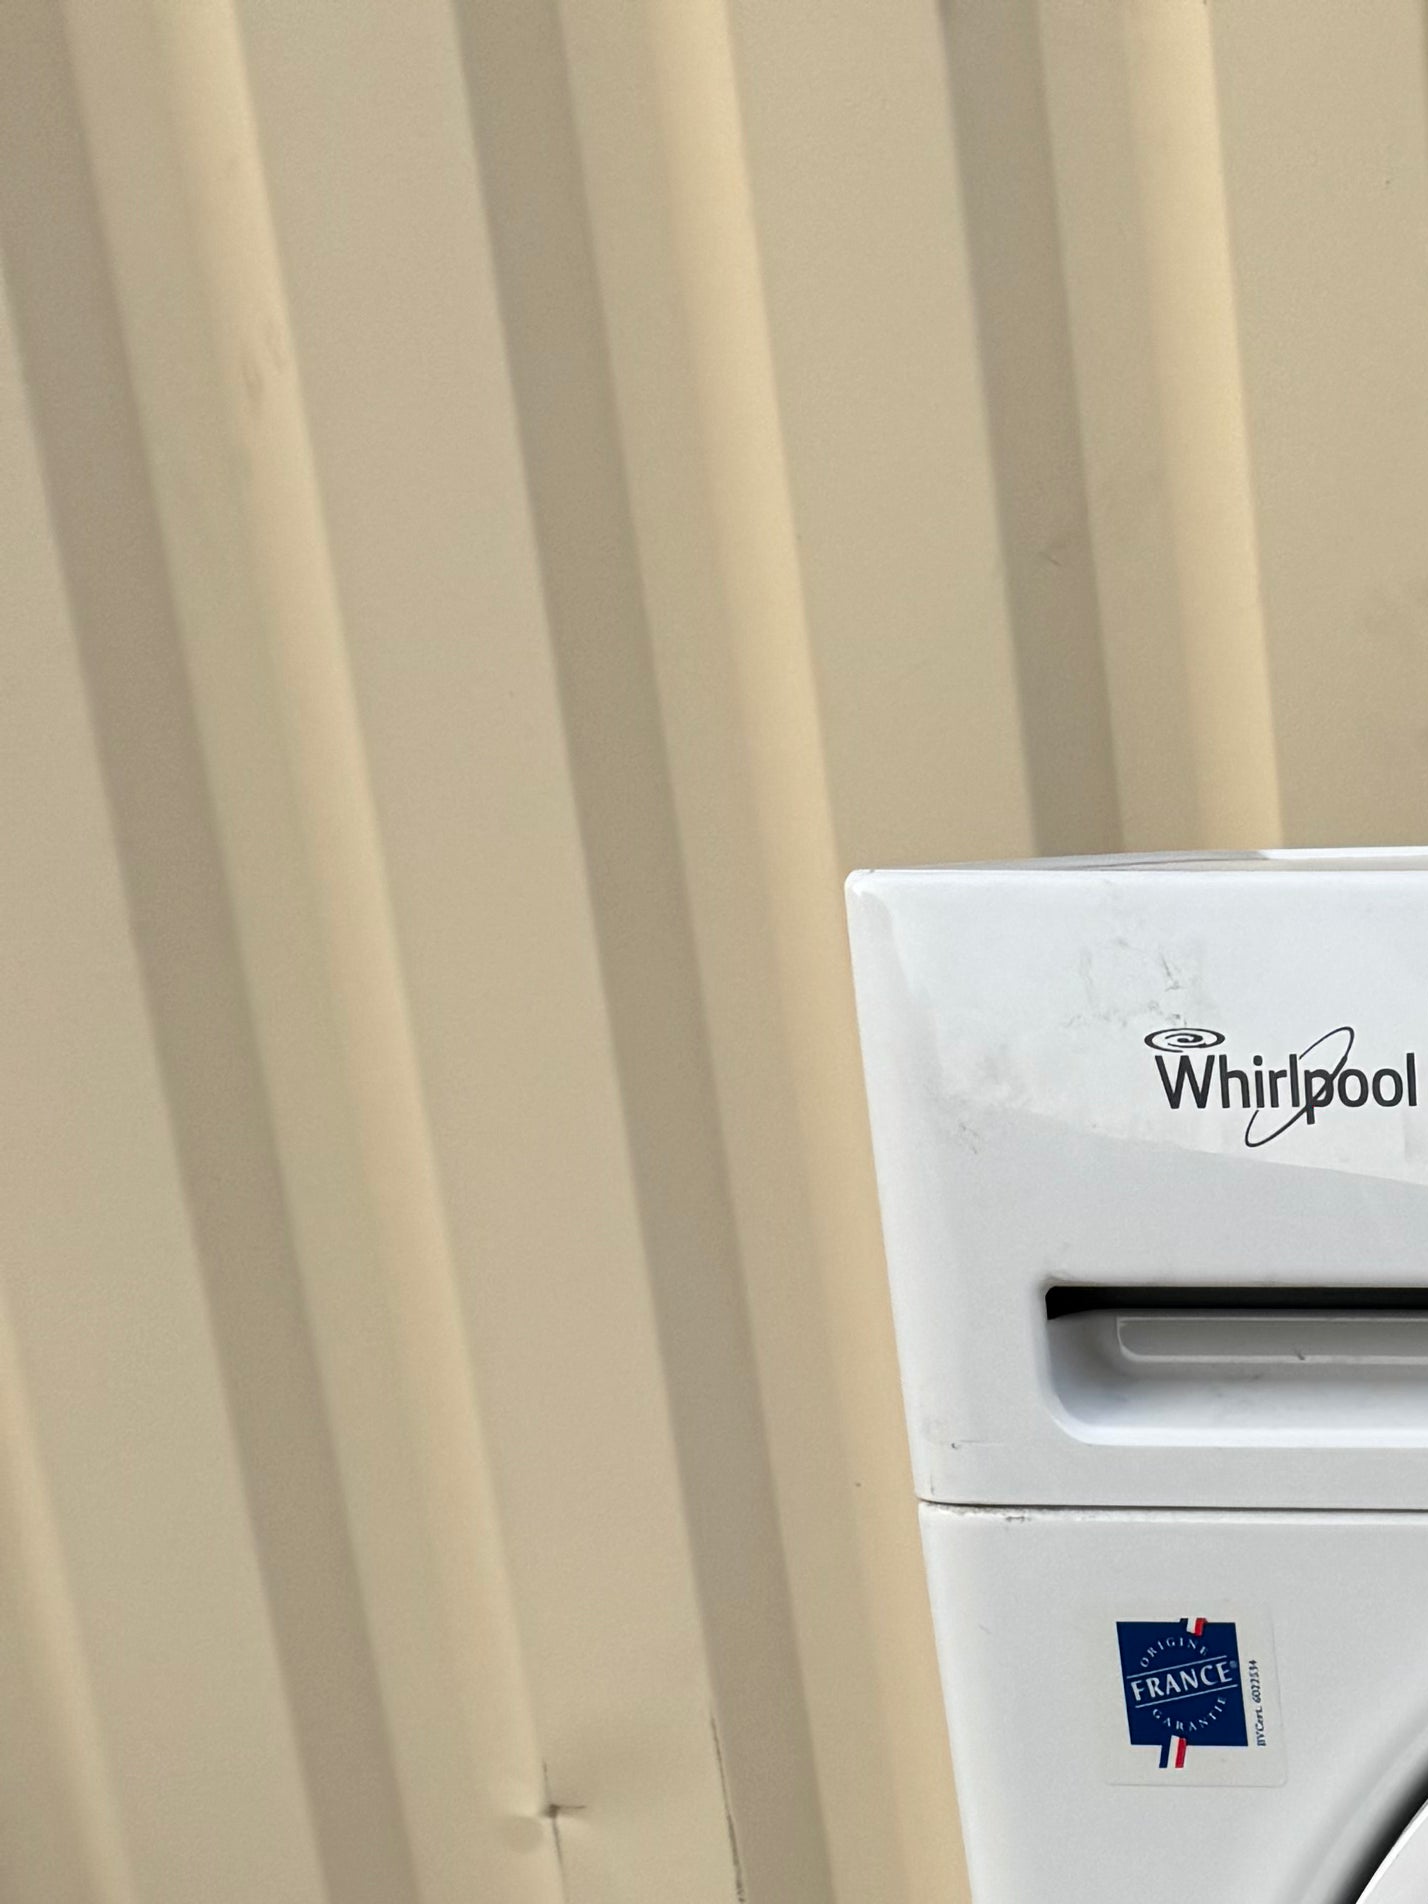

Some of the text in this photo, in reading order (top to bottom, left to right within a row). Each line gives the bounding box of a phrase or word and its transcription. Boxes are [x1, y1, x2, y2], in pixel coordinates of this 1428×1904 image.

[1154, 1052, 1417, 1126] Whirlpool
[1140, 1637, 1208, 1668] ORIGINE
[1130, 1661, 1233, 1701] FRANCE
[1152, 1697, 1227, 1731] GARANTIE
